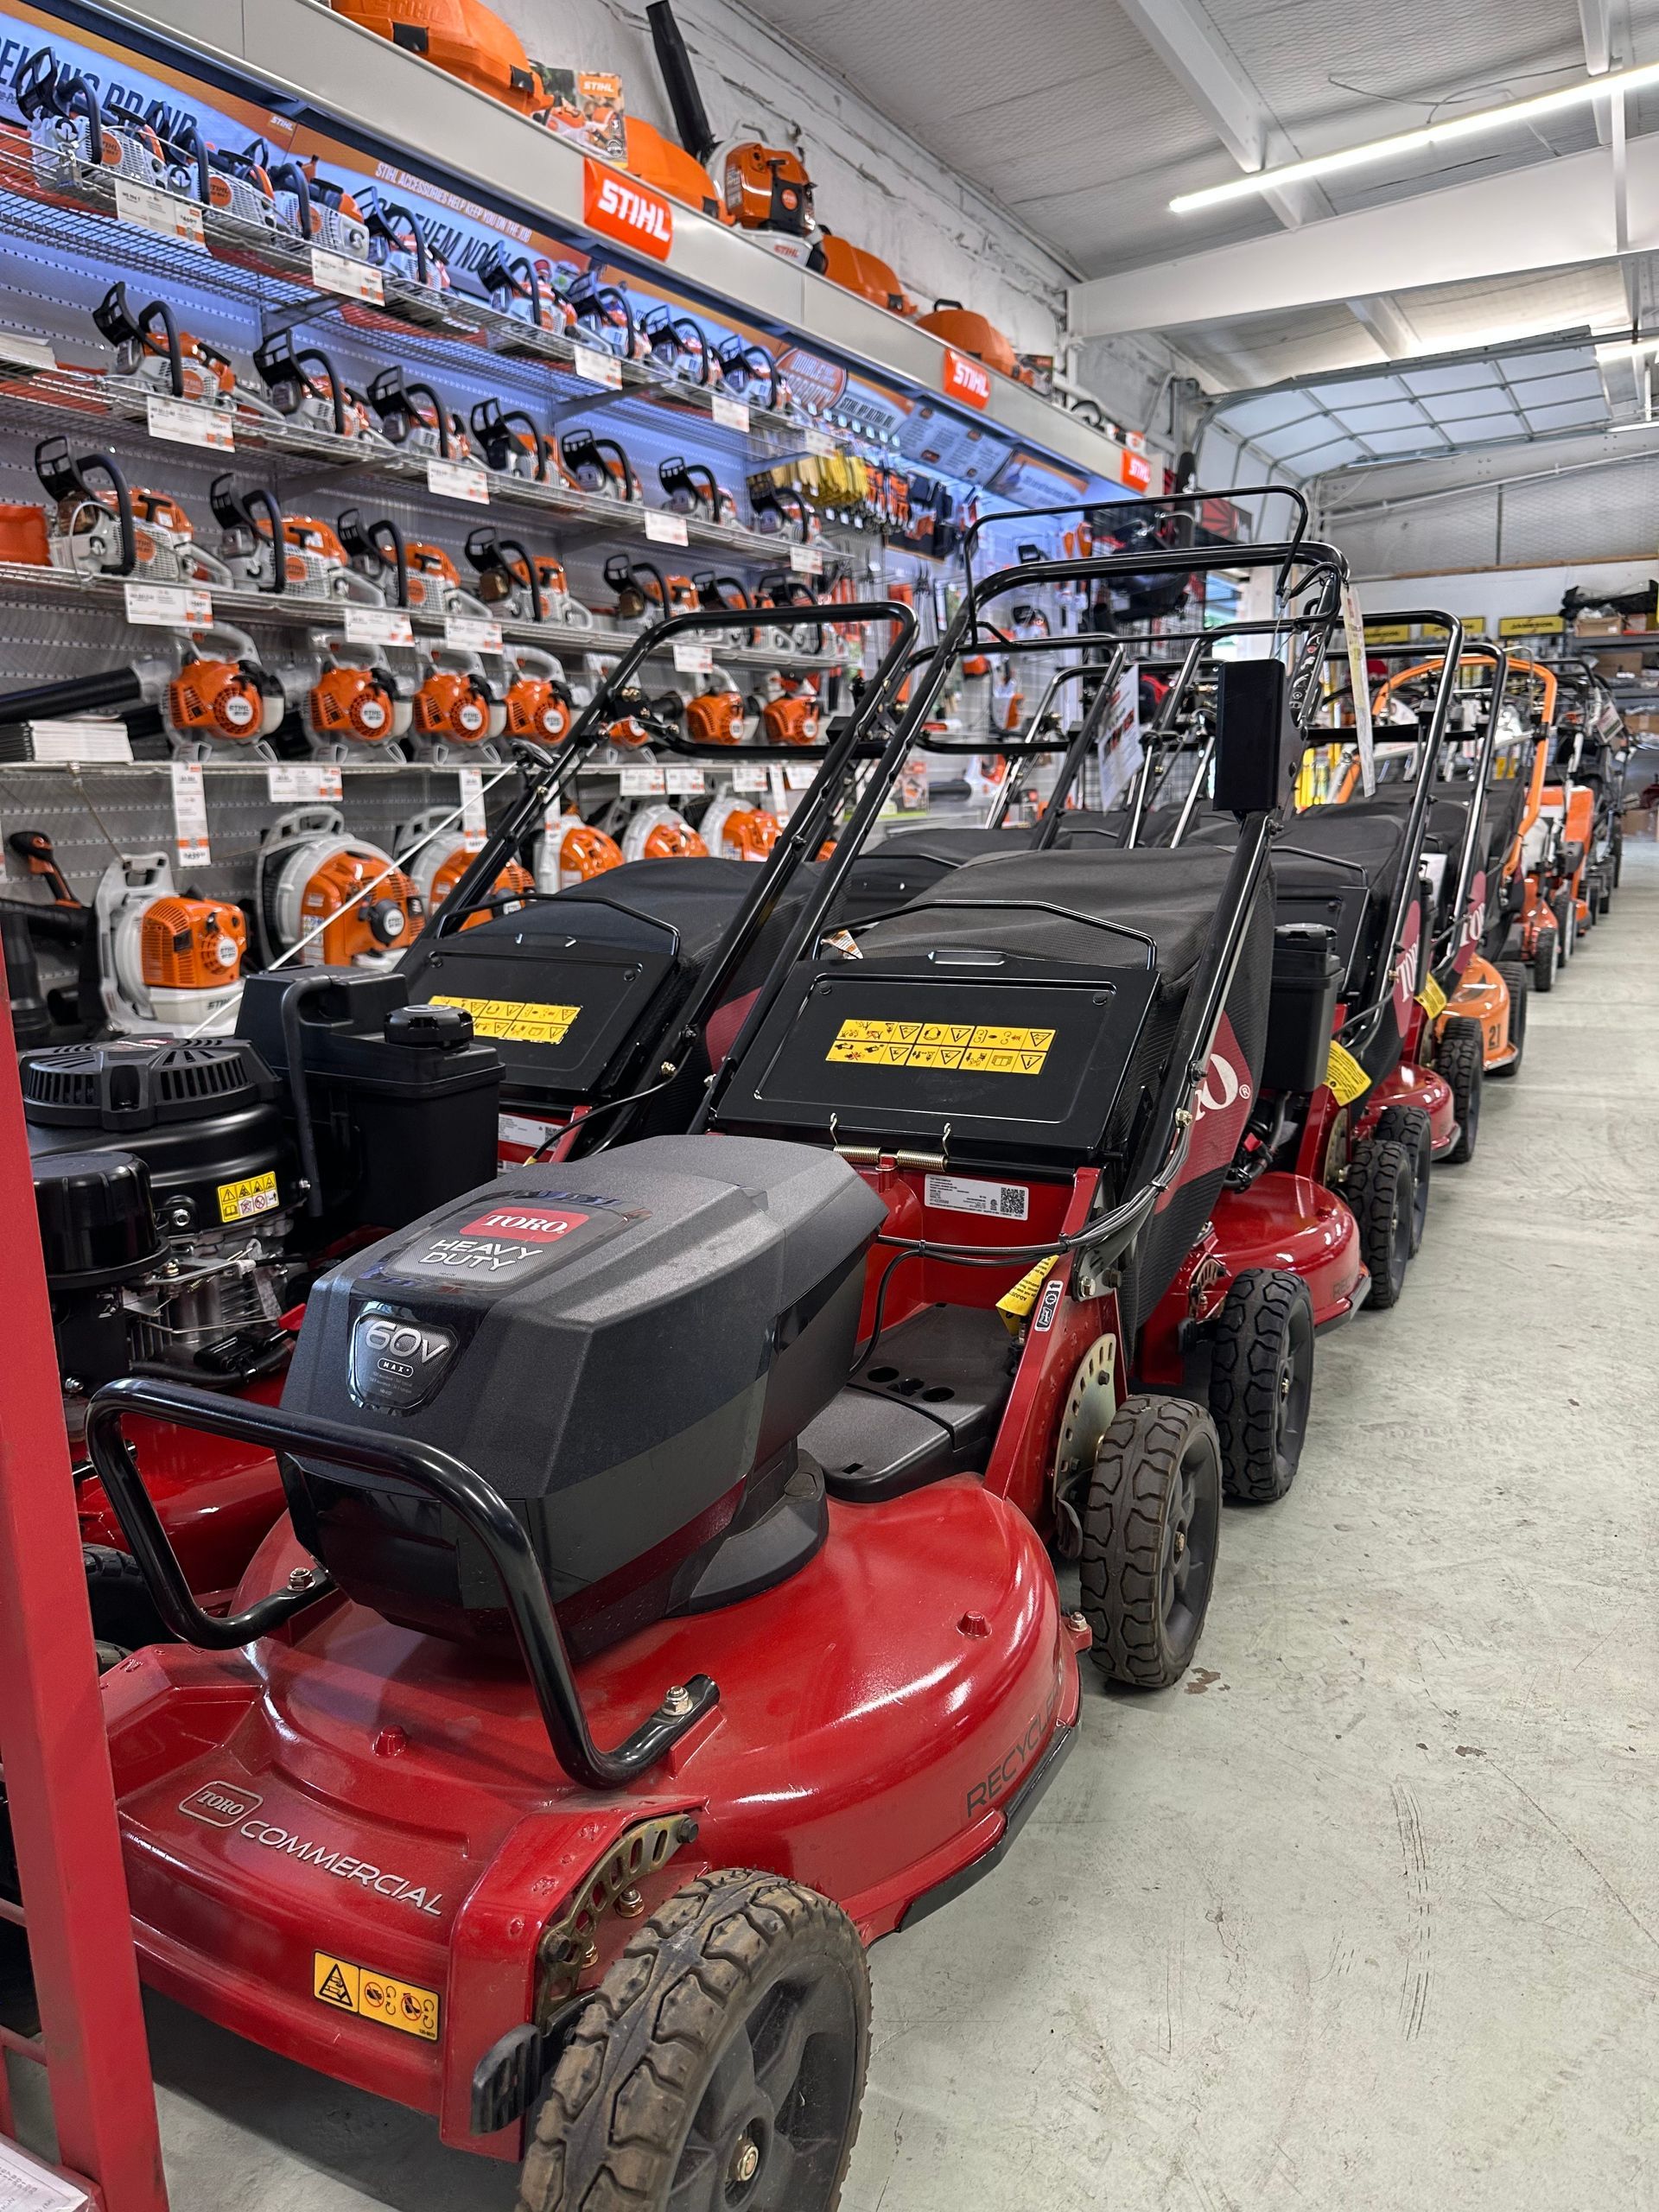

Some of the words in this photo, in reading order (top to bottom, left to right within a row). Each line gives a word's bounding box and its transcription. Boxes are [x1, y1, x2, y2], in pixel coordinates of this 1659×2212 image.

[583, 80, 614, 93] STIHL
[270, 116, 294, 131] STIHL
[375, 162, 398, 184] STIHL
[399, 170, 448, 206] ACCESSORIES
[448, 193, 467, 213] HELP
[466, 201, 485, 219] KEEP
[483, 207, 496, 226] YOU
[495, 214, 508, 232] ON
[506, 219, 521, 238] THE
[518, 226, 533, 244] JOB
[598, 179, 671, 243] STIHL
[773, 245, 799, 258] STIHL
[953, 362, 989, 397] STIHL
[1128, 458, 1150, 483] STIHL
[1488, 1023, 1501, 1048] 21
[480, 1214, 566, 1235] TORO
[419, 1251, 516, 1271] DUTY
[429, 1238, 543, 1261] HEAVY
[197, 1789, 246, 1817] TORO
[240, 1820, 443, 1916] COMMERCIAL
